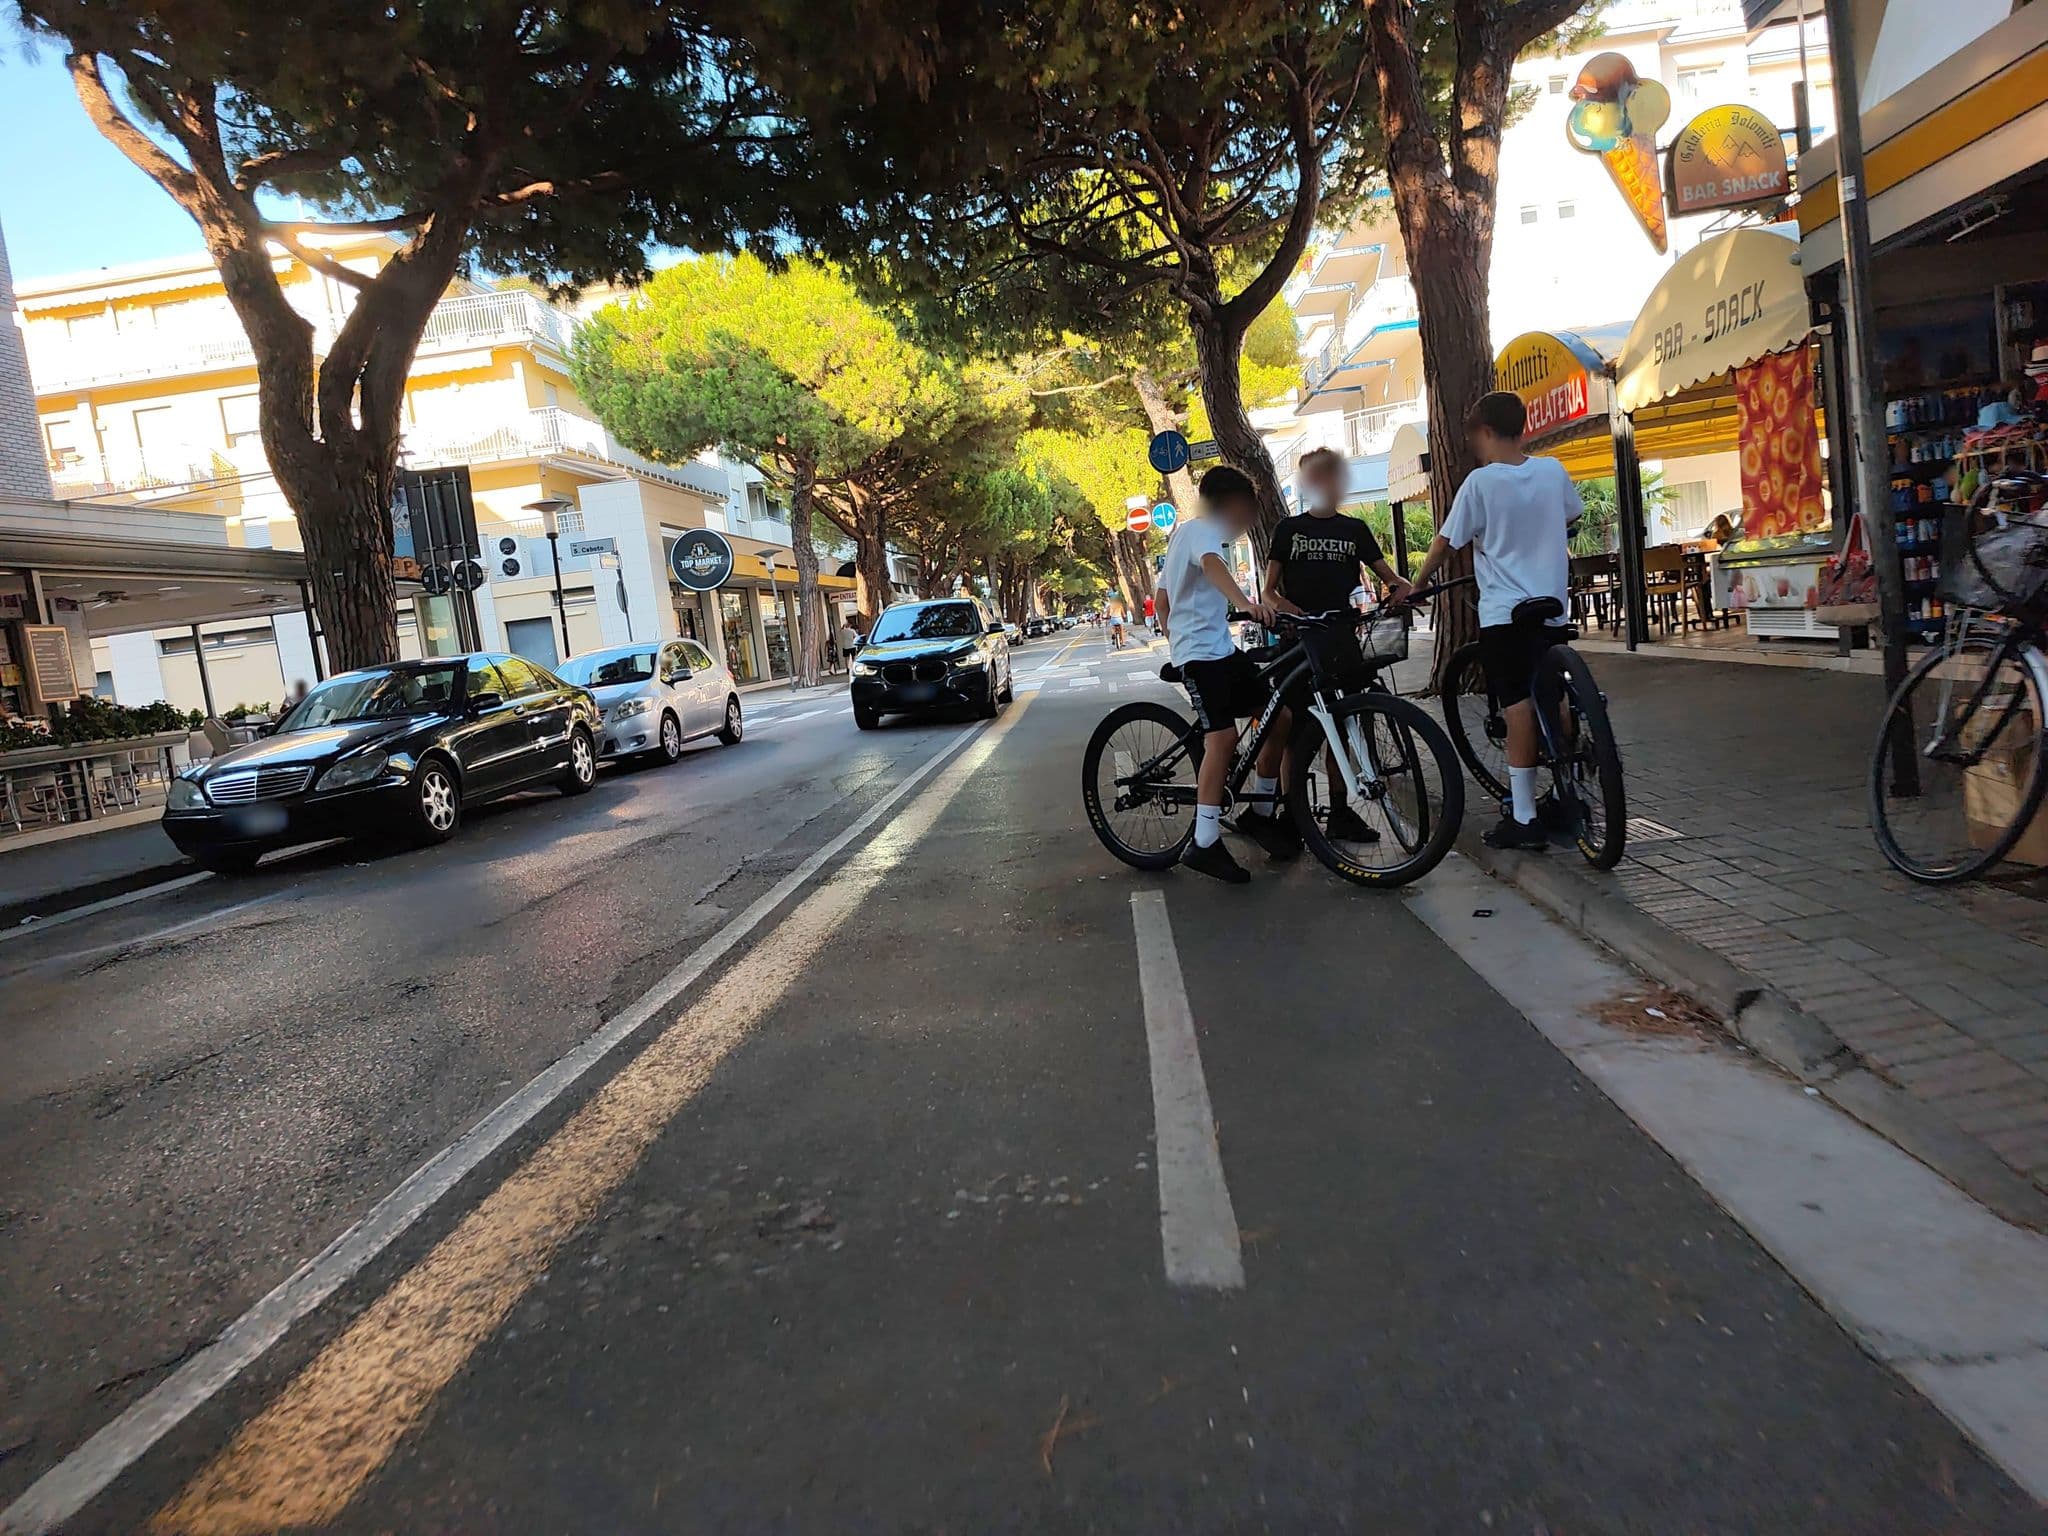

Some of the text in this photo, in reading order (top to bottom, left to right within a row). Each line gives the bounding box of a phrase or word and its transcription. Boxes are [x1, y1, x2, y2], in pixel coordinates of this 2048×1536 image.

[1730, 111, 1777, 150] Dolomiti
[1682, 171, 1781, 202] BAR SNACK
[1653, 321, 1683, 366] BAR
[1703, 279, 1765, 344] SNACK
[1526, 376, 1585, 432] GELATERIA
[680, 556, 722, 569] TOP MARKET
[1299, 538, 1357, 556] BOXEUR
[1307, 552, 1324, 560] DES
